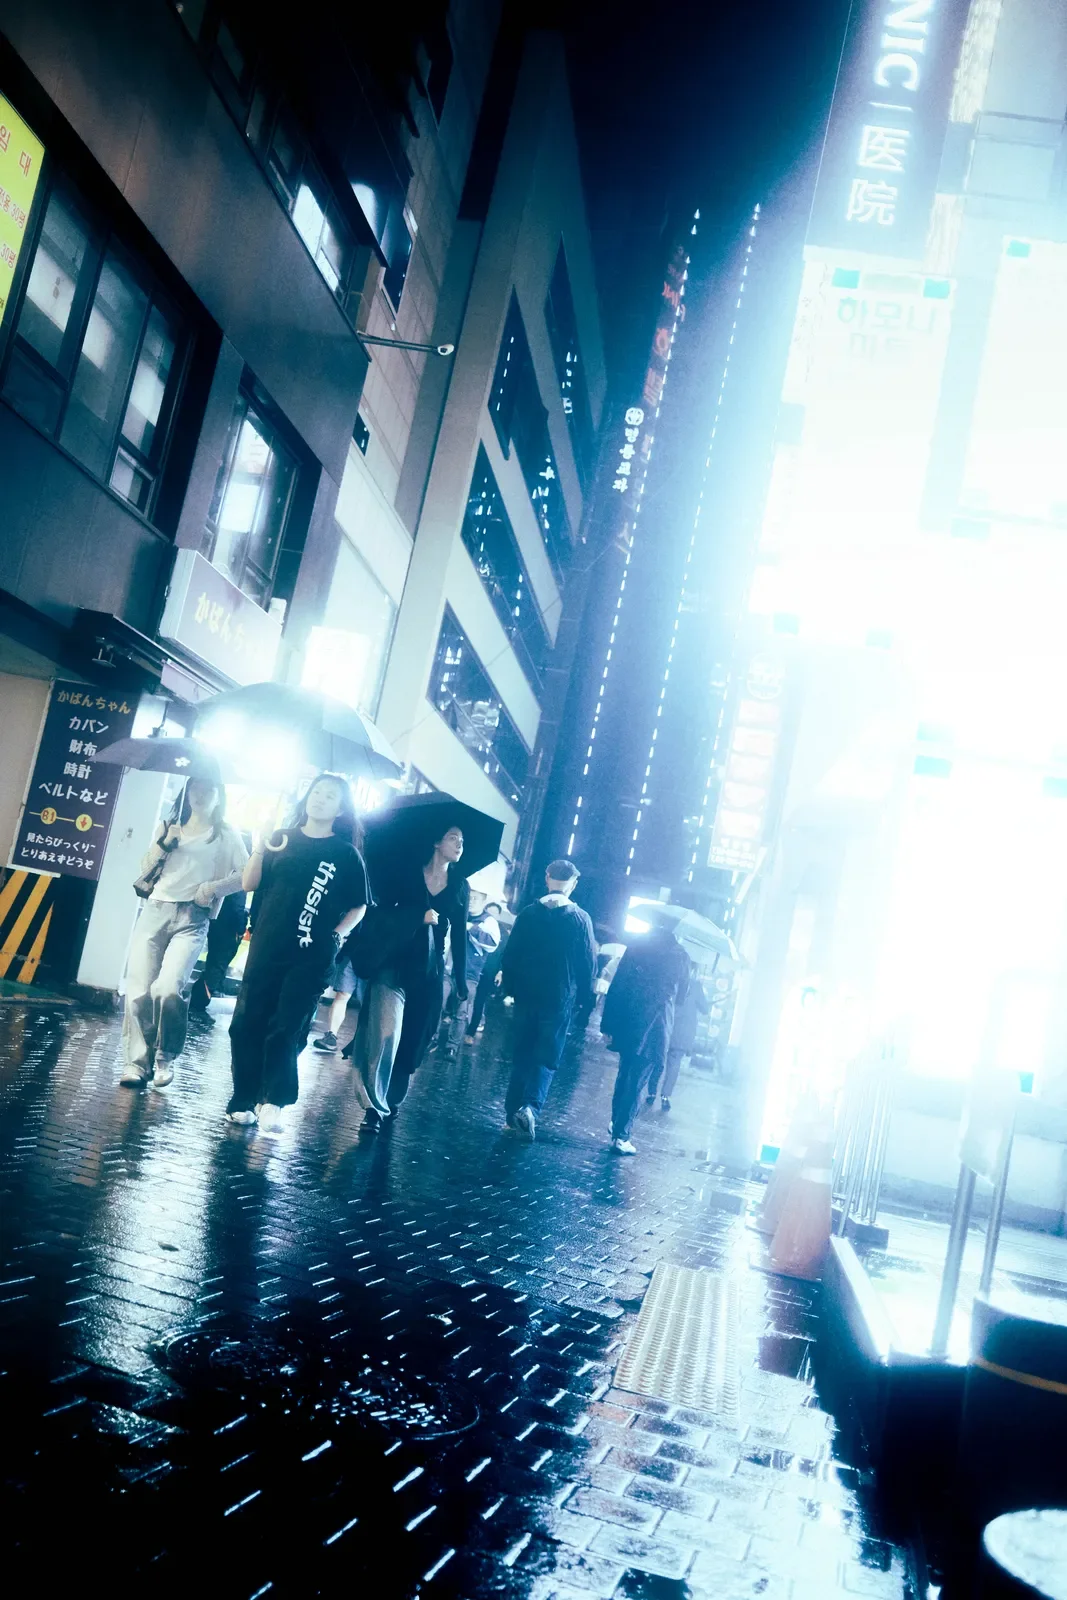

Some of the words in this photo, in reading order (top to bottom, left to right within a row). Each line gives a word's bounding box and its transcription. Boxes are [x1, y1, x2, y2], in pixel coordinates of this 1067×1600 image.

[846, 124, 912, 226] 医院
[57, 690, 131, 714] かばんちゃん
[68, 716, 109, 734] カバン
[68, 738, 98, 757] 財布
[63, 761, 92, 780] 時計
[39, 782, 108, 805] ベルトなど
[42, 809, 56, 822] B1
[21, 847, 95, 870] とりあえずどうぞ
